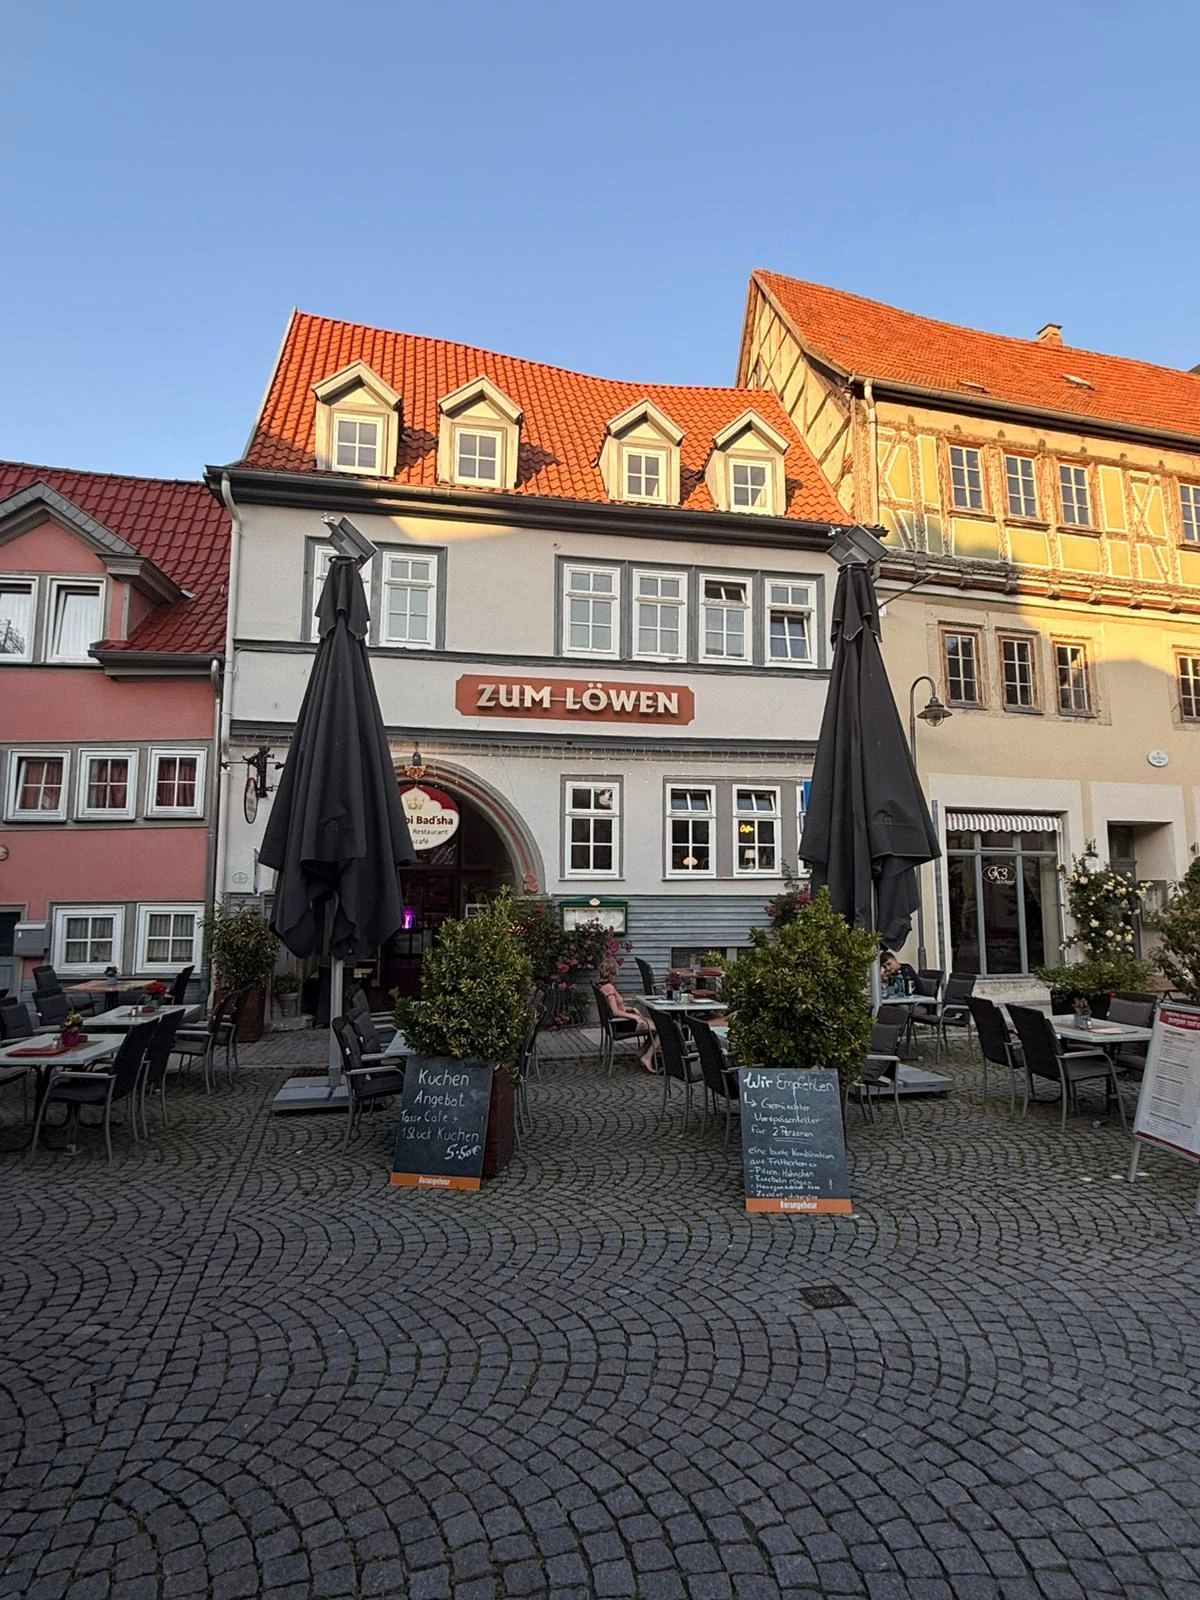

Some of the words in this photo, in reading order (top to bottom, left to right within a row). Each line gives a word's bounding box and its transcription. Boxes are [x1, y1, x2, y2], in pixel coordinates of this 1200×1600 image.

[476, 684, 551, 709] ZUM
[565, 682, 679, 714] LÖWEN
[412, 828, 449, 836] Restaurant
[418, 1068, 470, 1087] Kuchen
[743, 1071, 773, 1089] Wir
[414, 1089, 465, 1108] Angebot
[436, 1127, 480, 1142] Kuchen
[772, 1126, 779, 1137] 2
